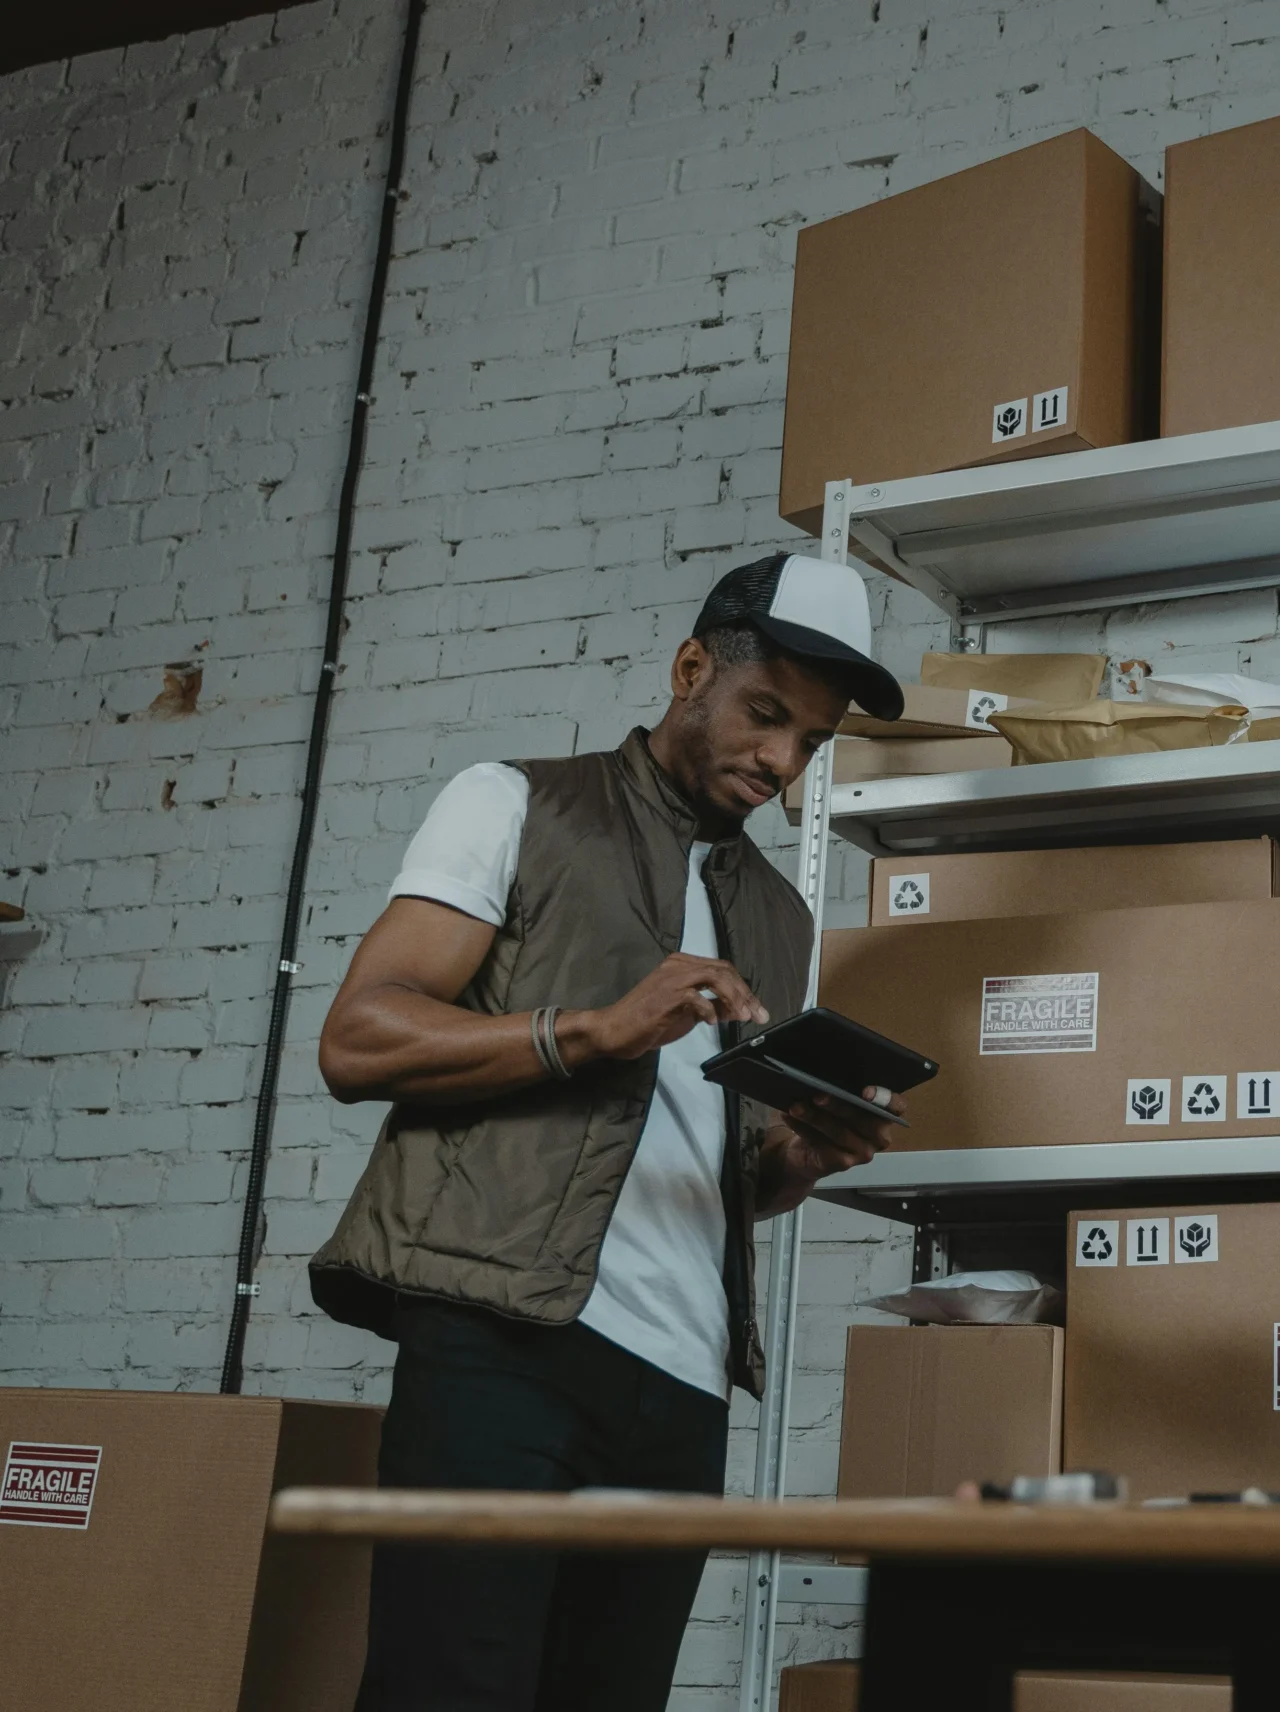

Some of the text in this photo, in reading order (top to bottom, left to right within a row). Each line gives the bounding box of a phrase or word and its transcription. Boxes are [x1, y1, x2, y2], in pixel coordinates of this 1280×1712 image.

[986, 998, 1091, 1021] FRAGILE
[986, 1019, 1090, 1032] HANDLE WITH CARE
[6, 1467, 93, 1493] FRAGILE
[4, 1489, 89, 1504] HANDLE WITH CARE
